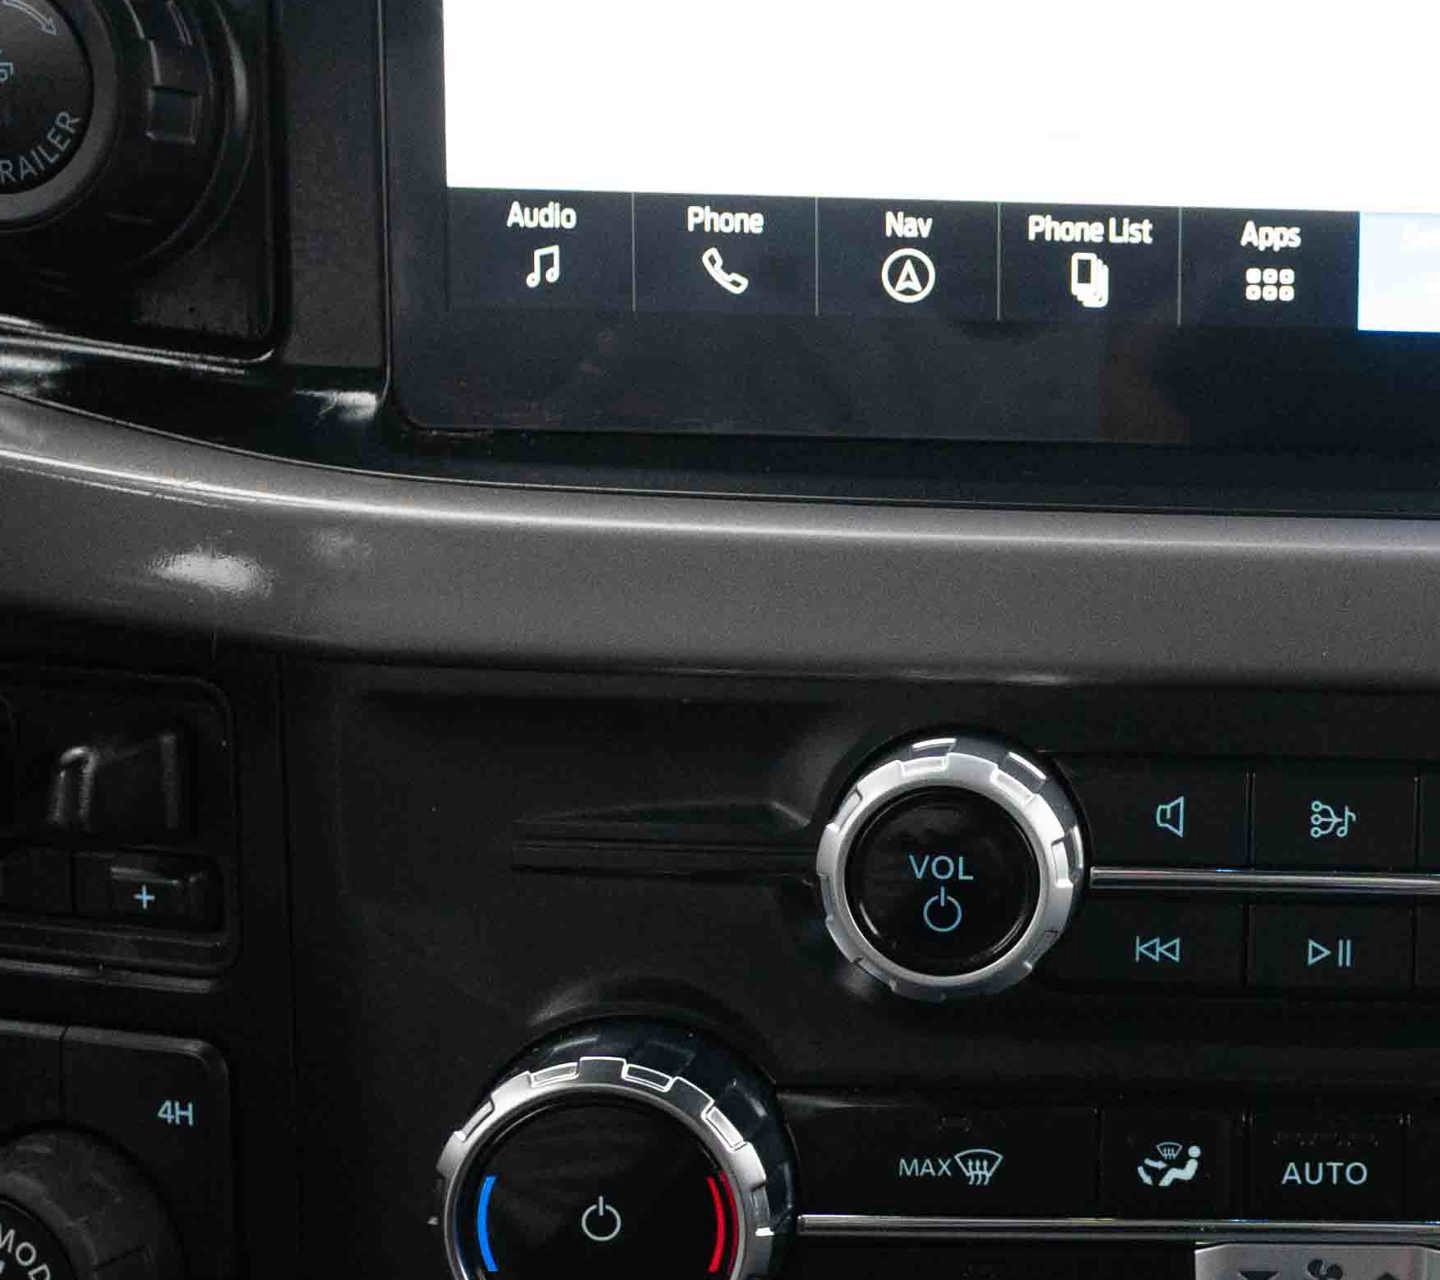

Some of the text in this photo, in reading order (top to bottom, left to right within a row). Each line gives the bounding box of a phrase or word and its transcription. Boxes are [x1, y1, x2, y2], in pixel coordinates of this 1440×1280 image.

[506, 201, 578, 231] Audio
[687, 206, 765, 236] Phone
[885, 210, 934, 240] Nav
[1027, 215, 1153, 246] Phone List
[1240, 219, 1302, 253] Apps
[908, 854, 975, 882] VOL
[157, 1099, 195, 1127] 4H
[898, 1157, 953, 1179] MAX
[1281, 1161, 1369, 1186] AUTO
